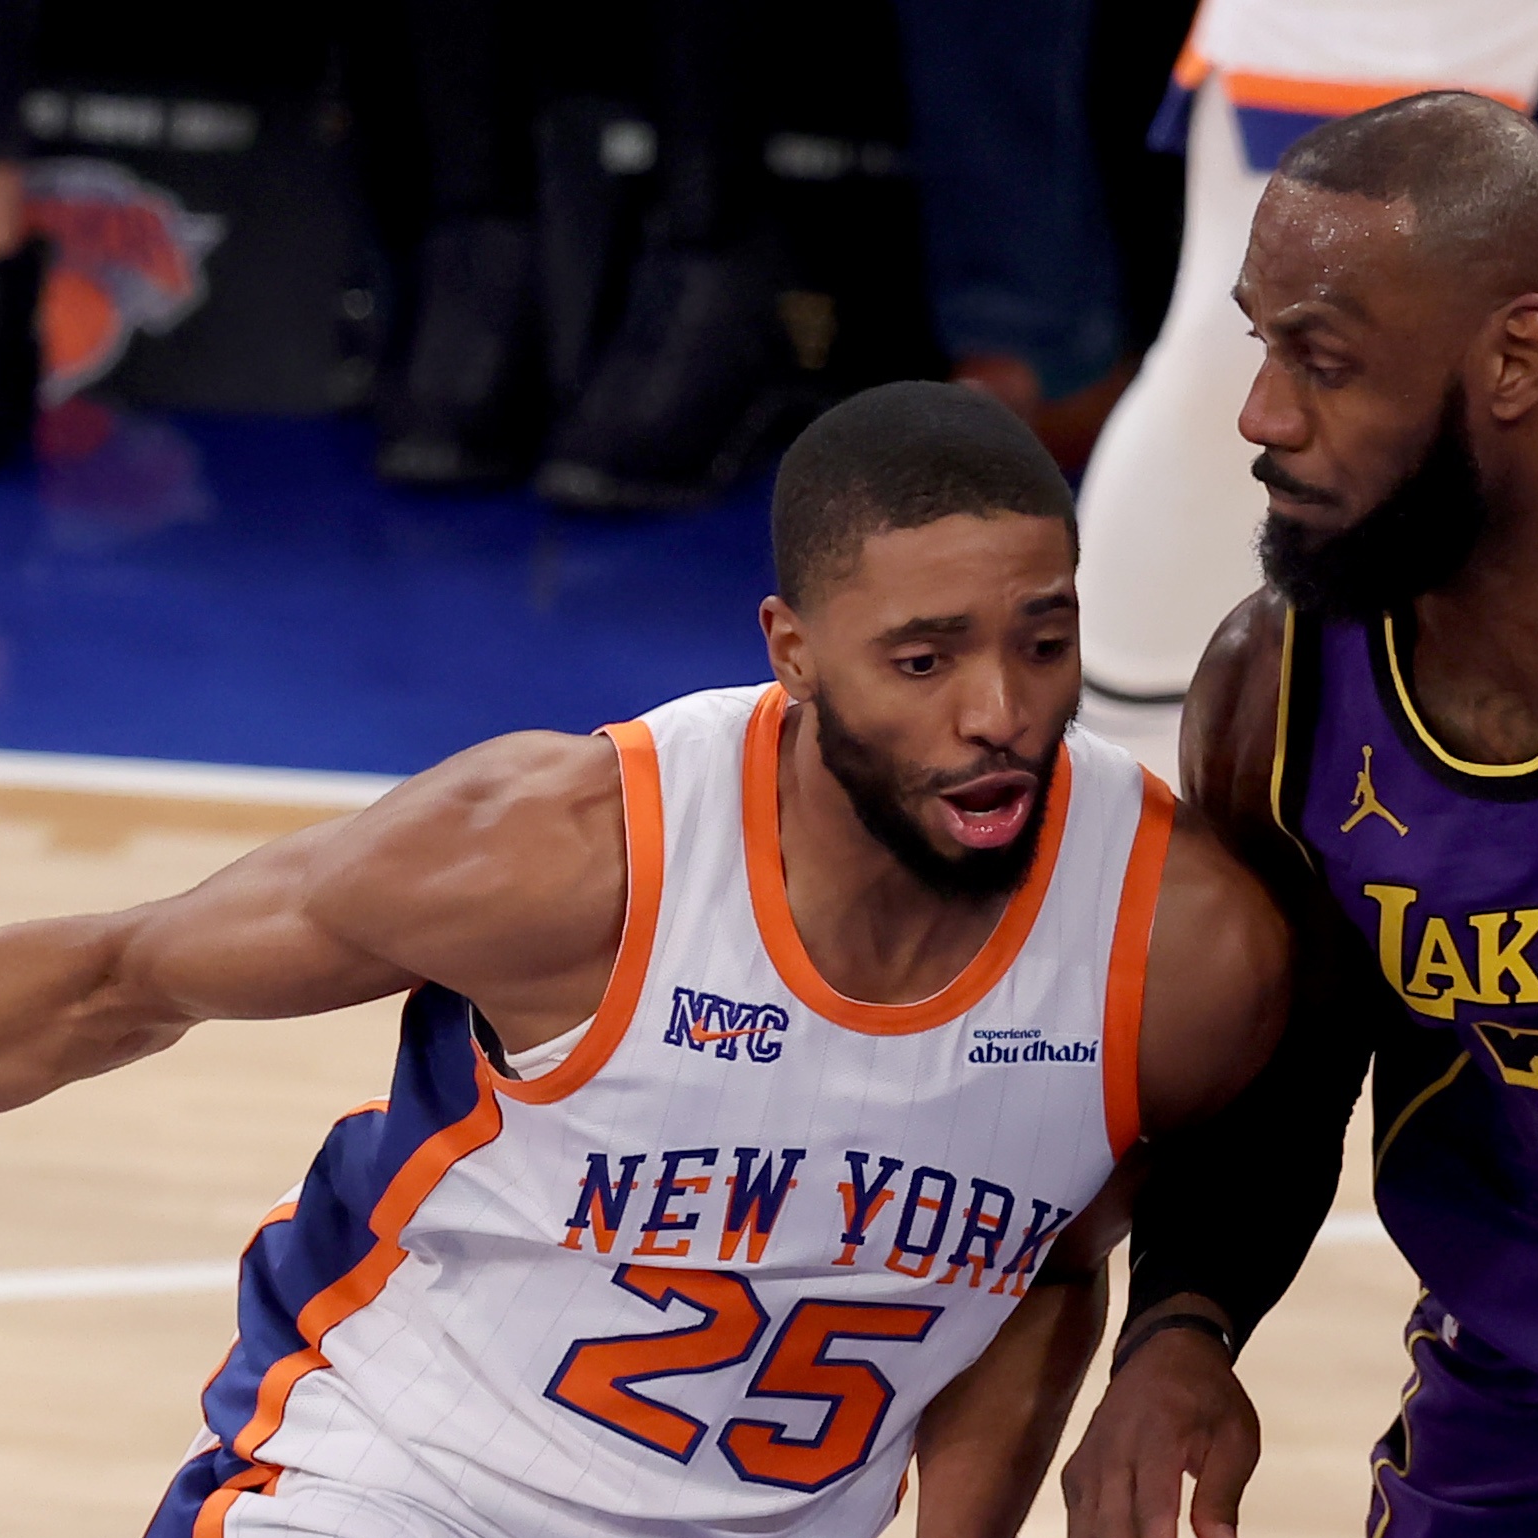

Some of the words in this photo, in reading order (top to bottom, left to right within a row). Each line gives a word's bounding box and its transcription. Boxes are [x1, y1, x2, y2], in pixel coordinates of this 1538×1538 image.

[662, 985, 790, 1063] NYC
[968, 1041, 1019, 1064] abu
[1023, 1040, 1099, 1063] dhabi
[972, 1028, 1042, 1041] experience
[558, 1148, 806, 1264] NEW
[832, 1149, 1073, 1297] YORK
[544, 1262, 943, 1493] 25
